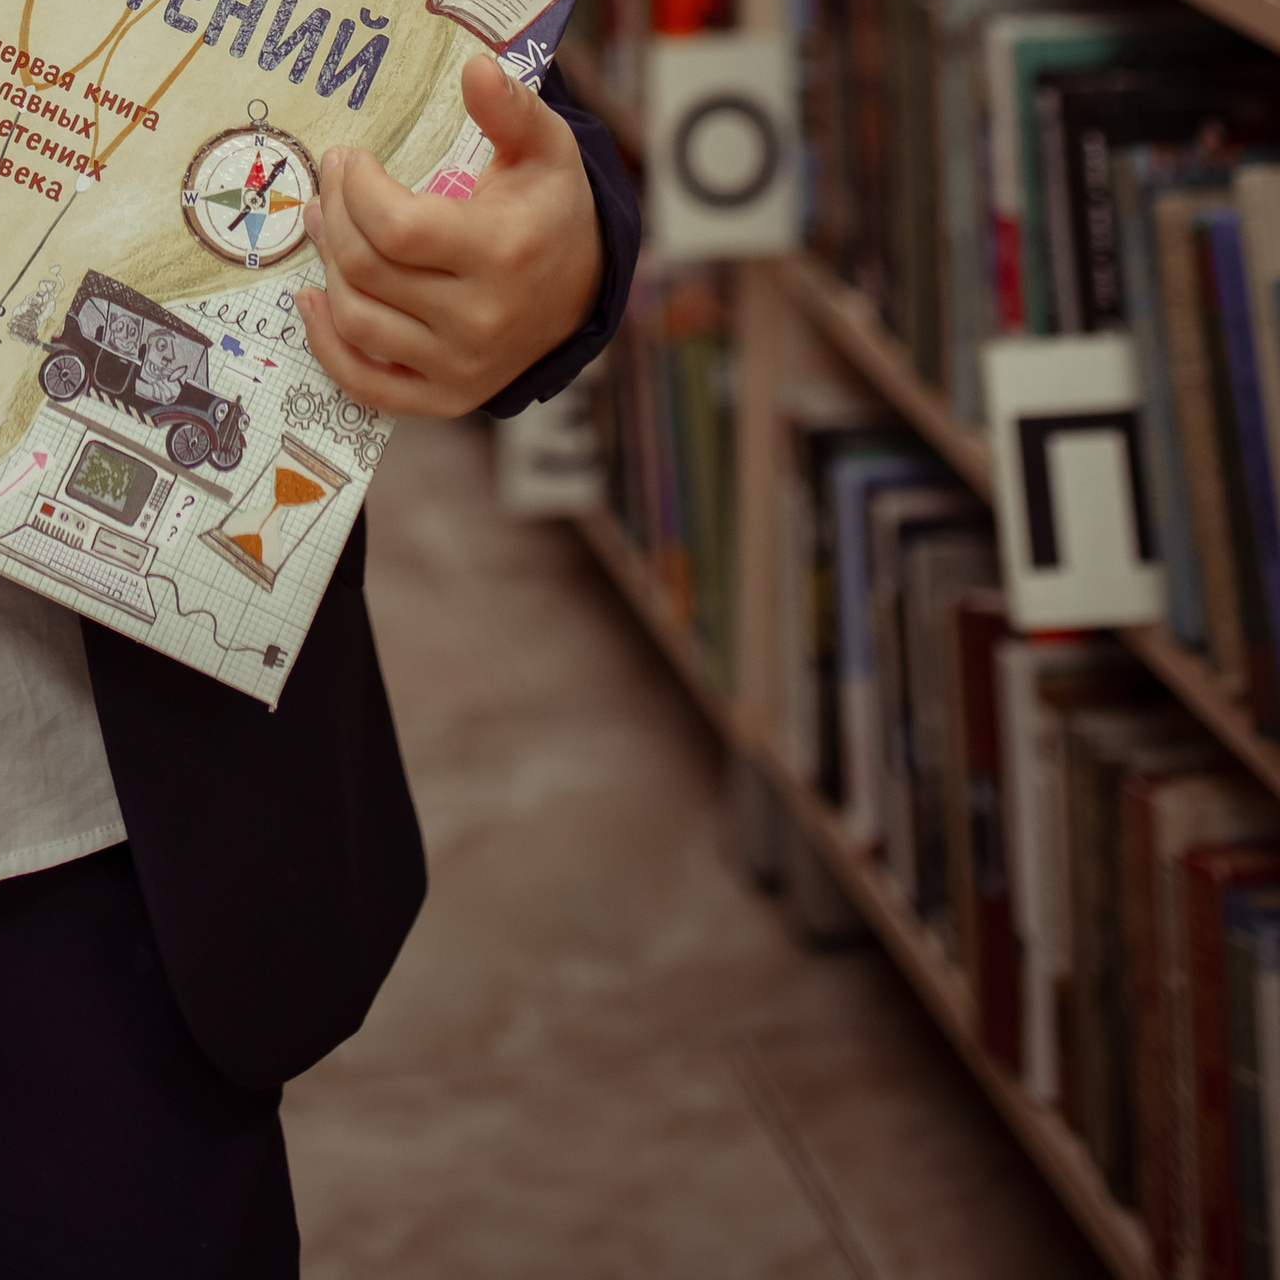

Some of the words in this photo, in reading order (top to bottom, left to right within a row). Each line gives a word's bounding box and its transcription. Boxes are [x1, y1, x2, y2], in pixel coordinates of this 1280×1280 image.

[83, 83, 161, 132] книга
[254, 135, 265, 147] N
[674, 94, 782, 210] О
[183, 191, 199, 205] W
[247, 252, 259, 267] S
[1018, 410, 1166, 568] П
